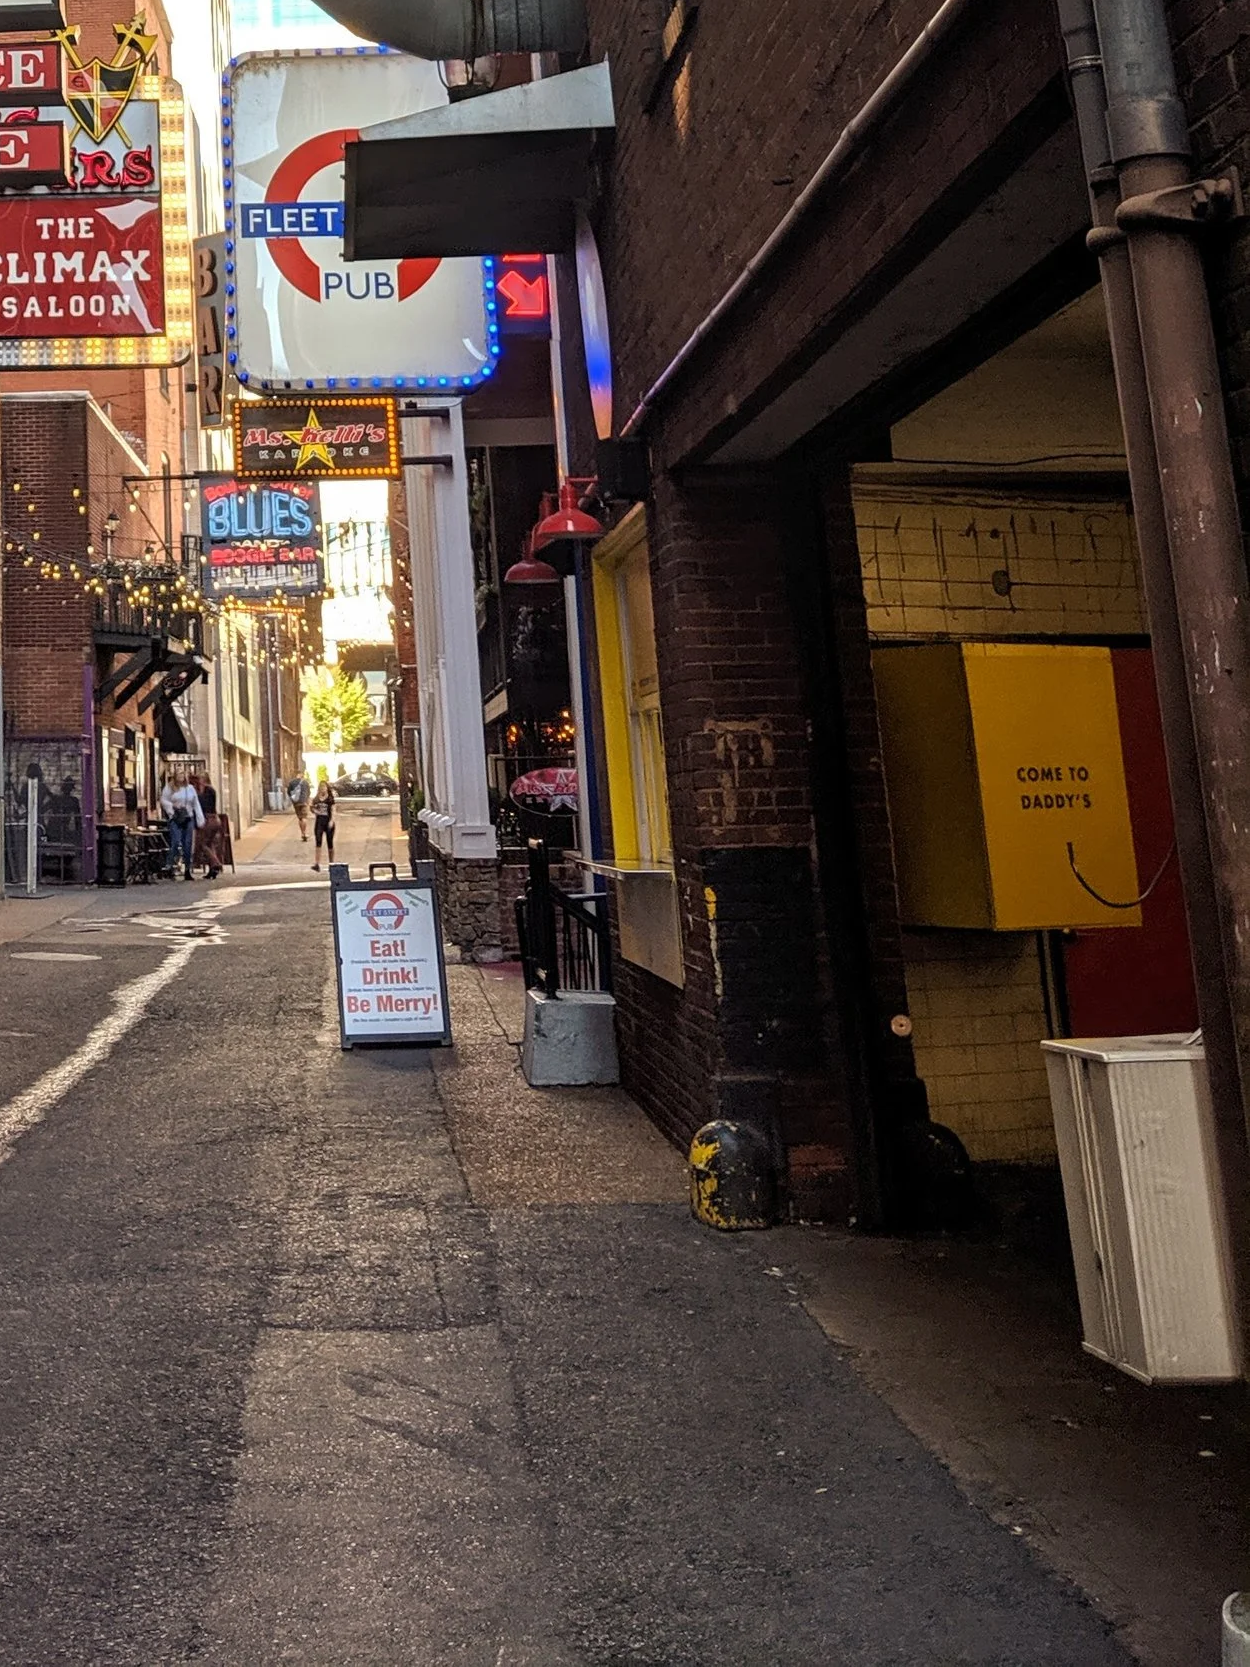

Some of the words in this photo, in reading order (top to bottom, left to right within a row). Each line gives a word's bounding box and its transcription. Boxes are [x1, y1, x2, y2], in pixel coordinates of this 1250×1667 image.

[36, 217, 95, 239] THE
[248, 207, 339, 233] FLEET
[324, 272, 395, 300] PUB
[2, 294, 131, 318] SALOON
[197, 247, 222, 416] BAR
[243, 427, 293, 447] Ms.
[209, 490, 312, 537] BLUES
[279, 546, 316, 562] BAR
[1016, 766, 1063, 782] COME
[1069, 766, 1089, 781] TO
[1021, 794, 1092, 809] DADDY'S
[370, 939, 406, 957] Eat!
[362, 966, 419, 985] Drink!
[347, 995, 371, 1014] Be
[376, 994, 438, 1015] Merry!
